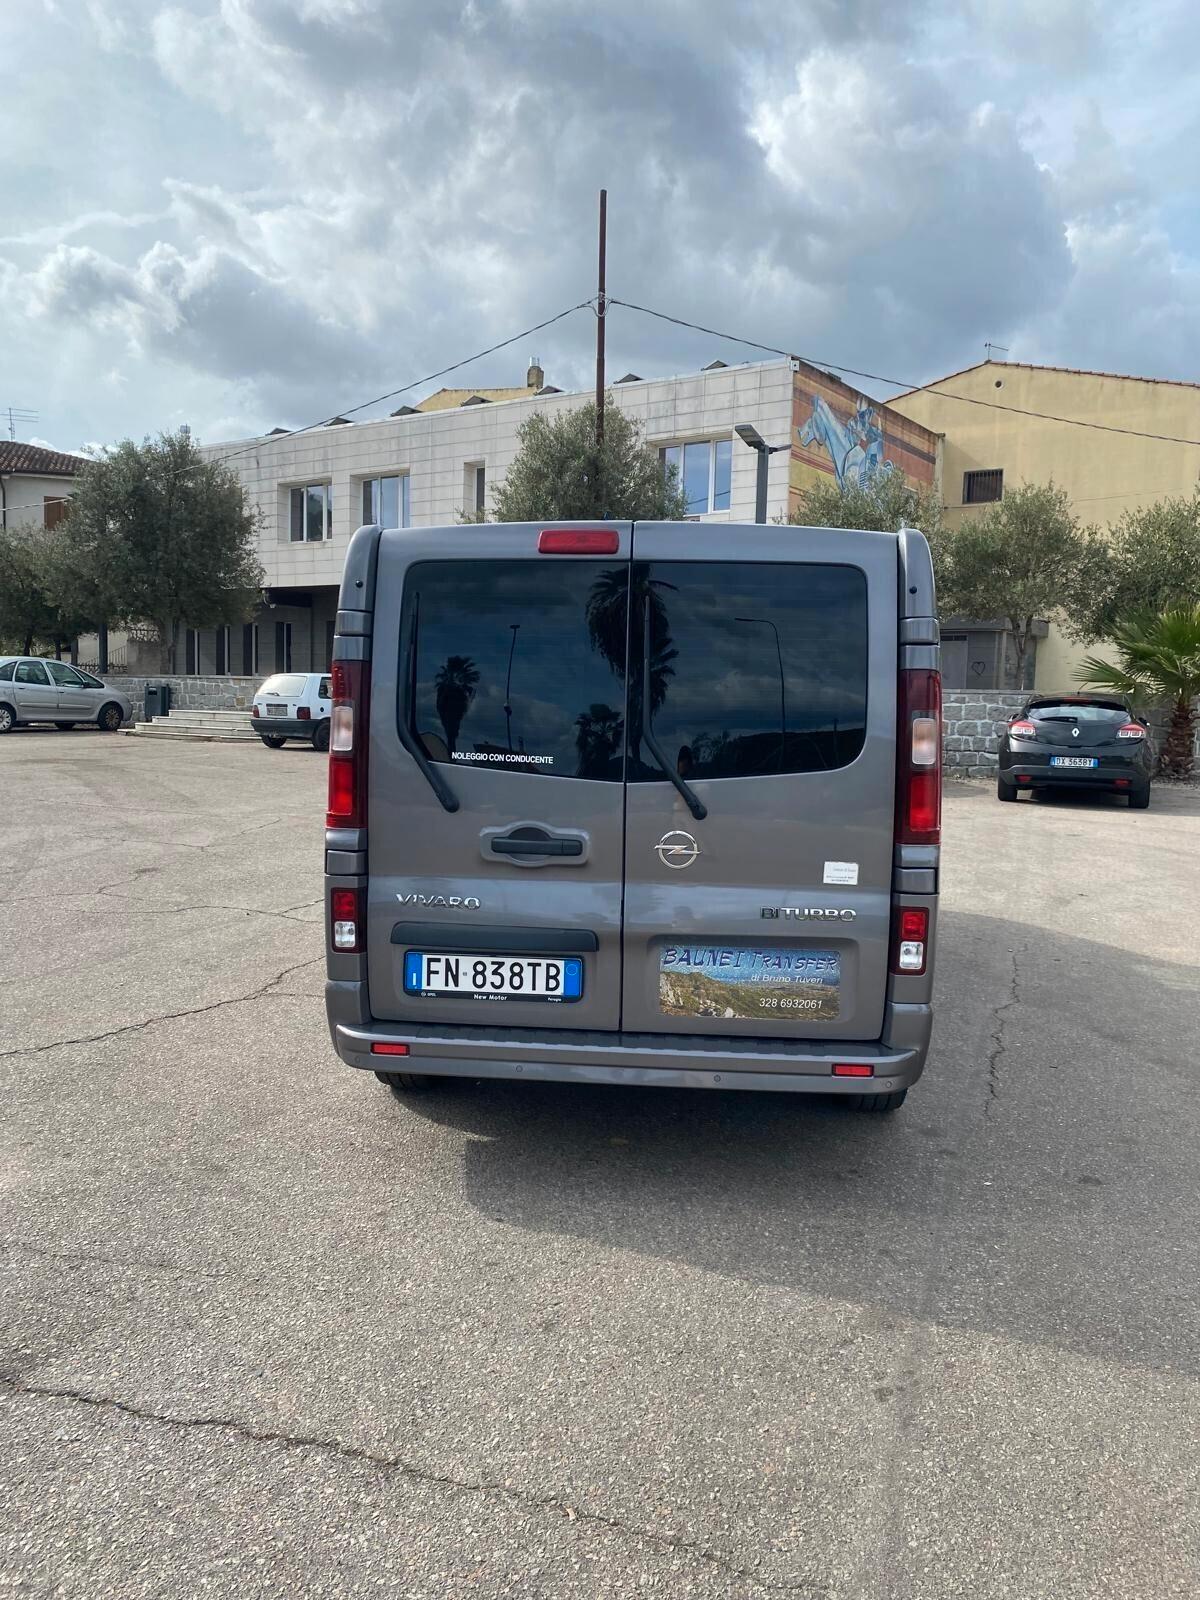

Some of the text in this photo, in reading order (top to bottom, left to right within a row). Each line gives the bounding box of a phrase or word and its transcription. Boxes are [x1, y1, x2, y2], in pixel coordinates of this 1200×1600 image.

[451, 751, 554, 765] NOLEGGIO CON CONDUCENTE
[1056, 757, 1066, 765] DX
[395, 893, 481, 910] VIVARO
[760, 906, 857, 922] BITURBO
[663, 948, 838, 972] BAUNEI TRANSFER
[426, 957, 460, 988] FN
[472, 960, 561, 992] 838TB
[750, 973, 823, 985] di Bruno Tuveri
[759, 998, 822, 1009] 328 6932061
